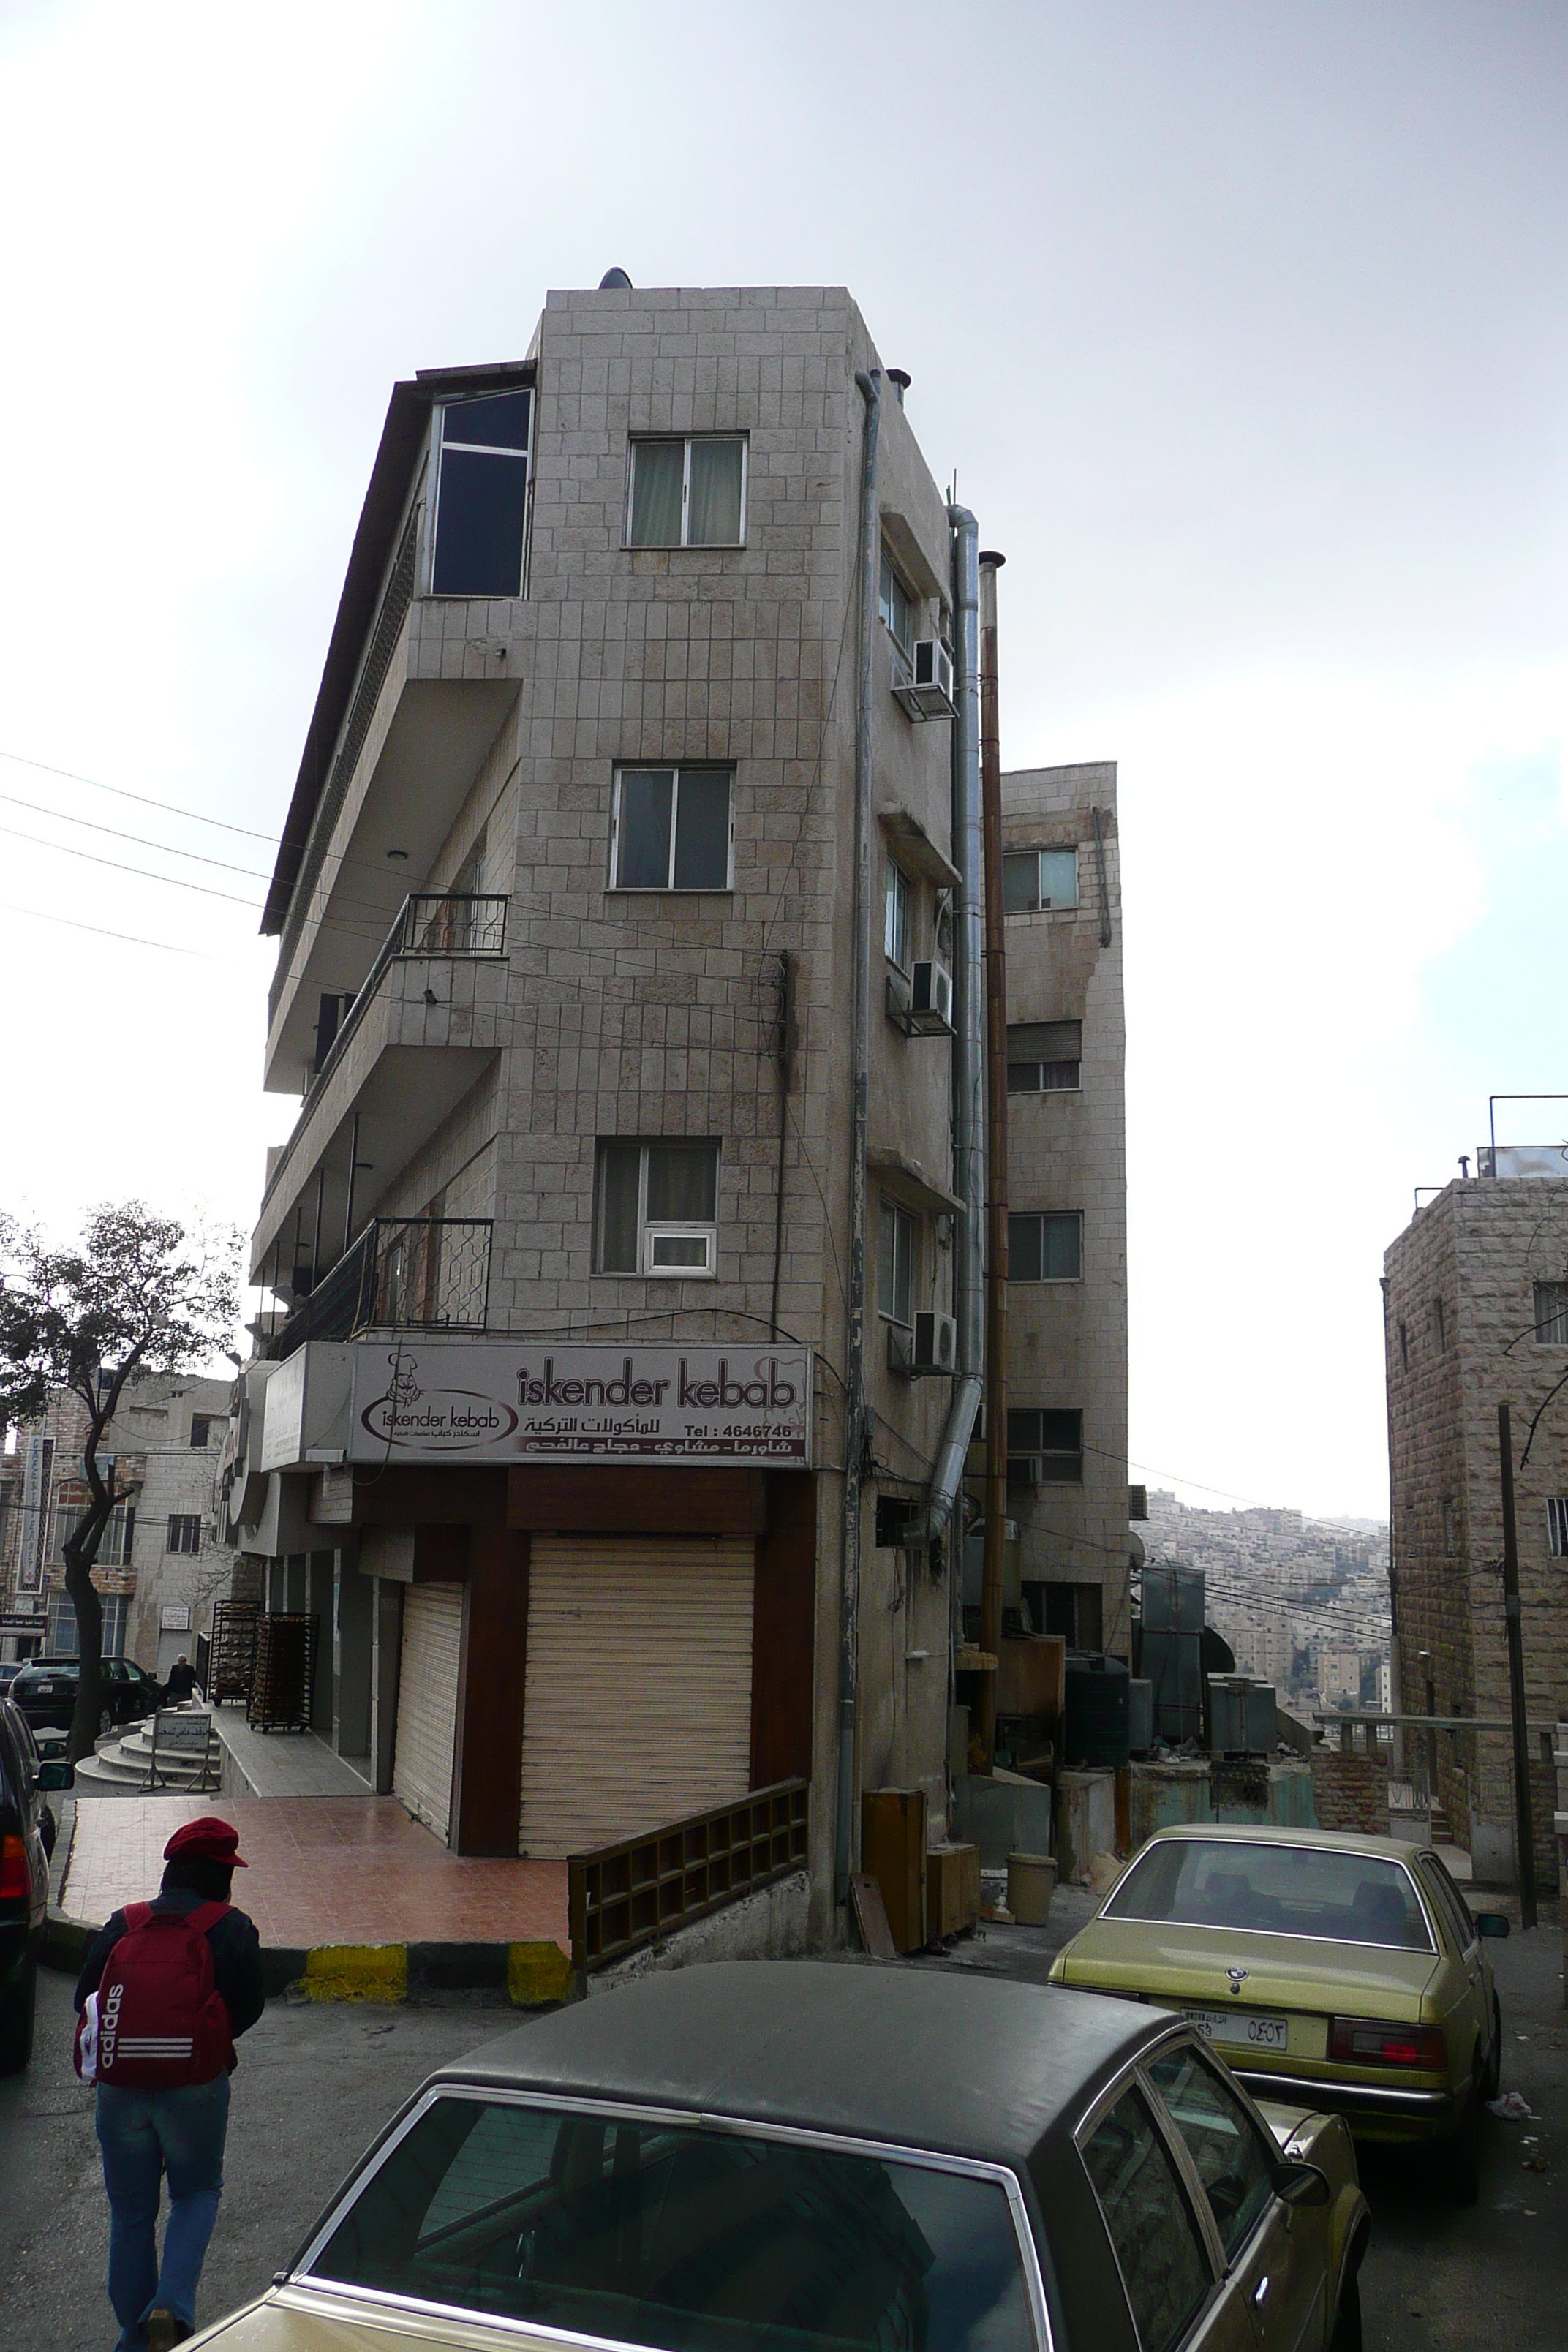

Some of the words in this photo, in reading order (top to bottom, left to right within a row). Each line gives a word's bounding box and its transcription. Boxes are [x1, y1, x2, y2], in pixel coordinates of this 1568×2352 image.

[516, 1357, 671, 1407] iskender
[677, 1358, 796, 1409] kebab
[382, 1406, 446, 1426] iskender
[451, 1406, 500, 1428] kebab
[524, 1417, 578, 1436] التركية
[581, 1414, 660, 1436] للمأكولات
[685, 1425, 708, 1437] Tel
[723, 1425, 791, 1438] 4646746
[654, 1439, 720, 1454] مشاوي
[734, 1439, 793, 1454] شاورما
[100, 1983, 124, 2069] adidas
